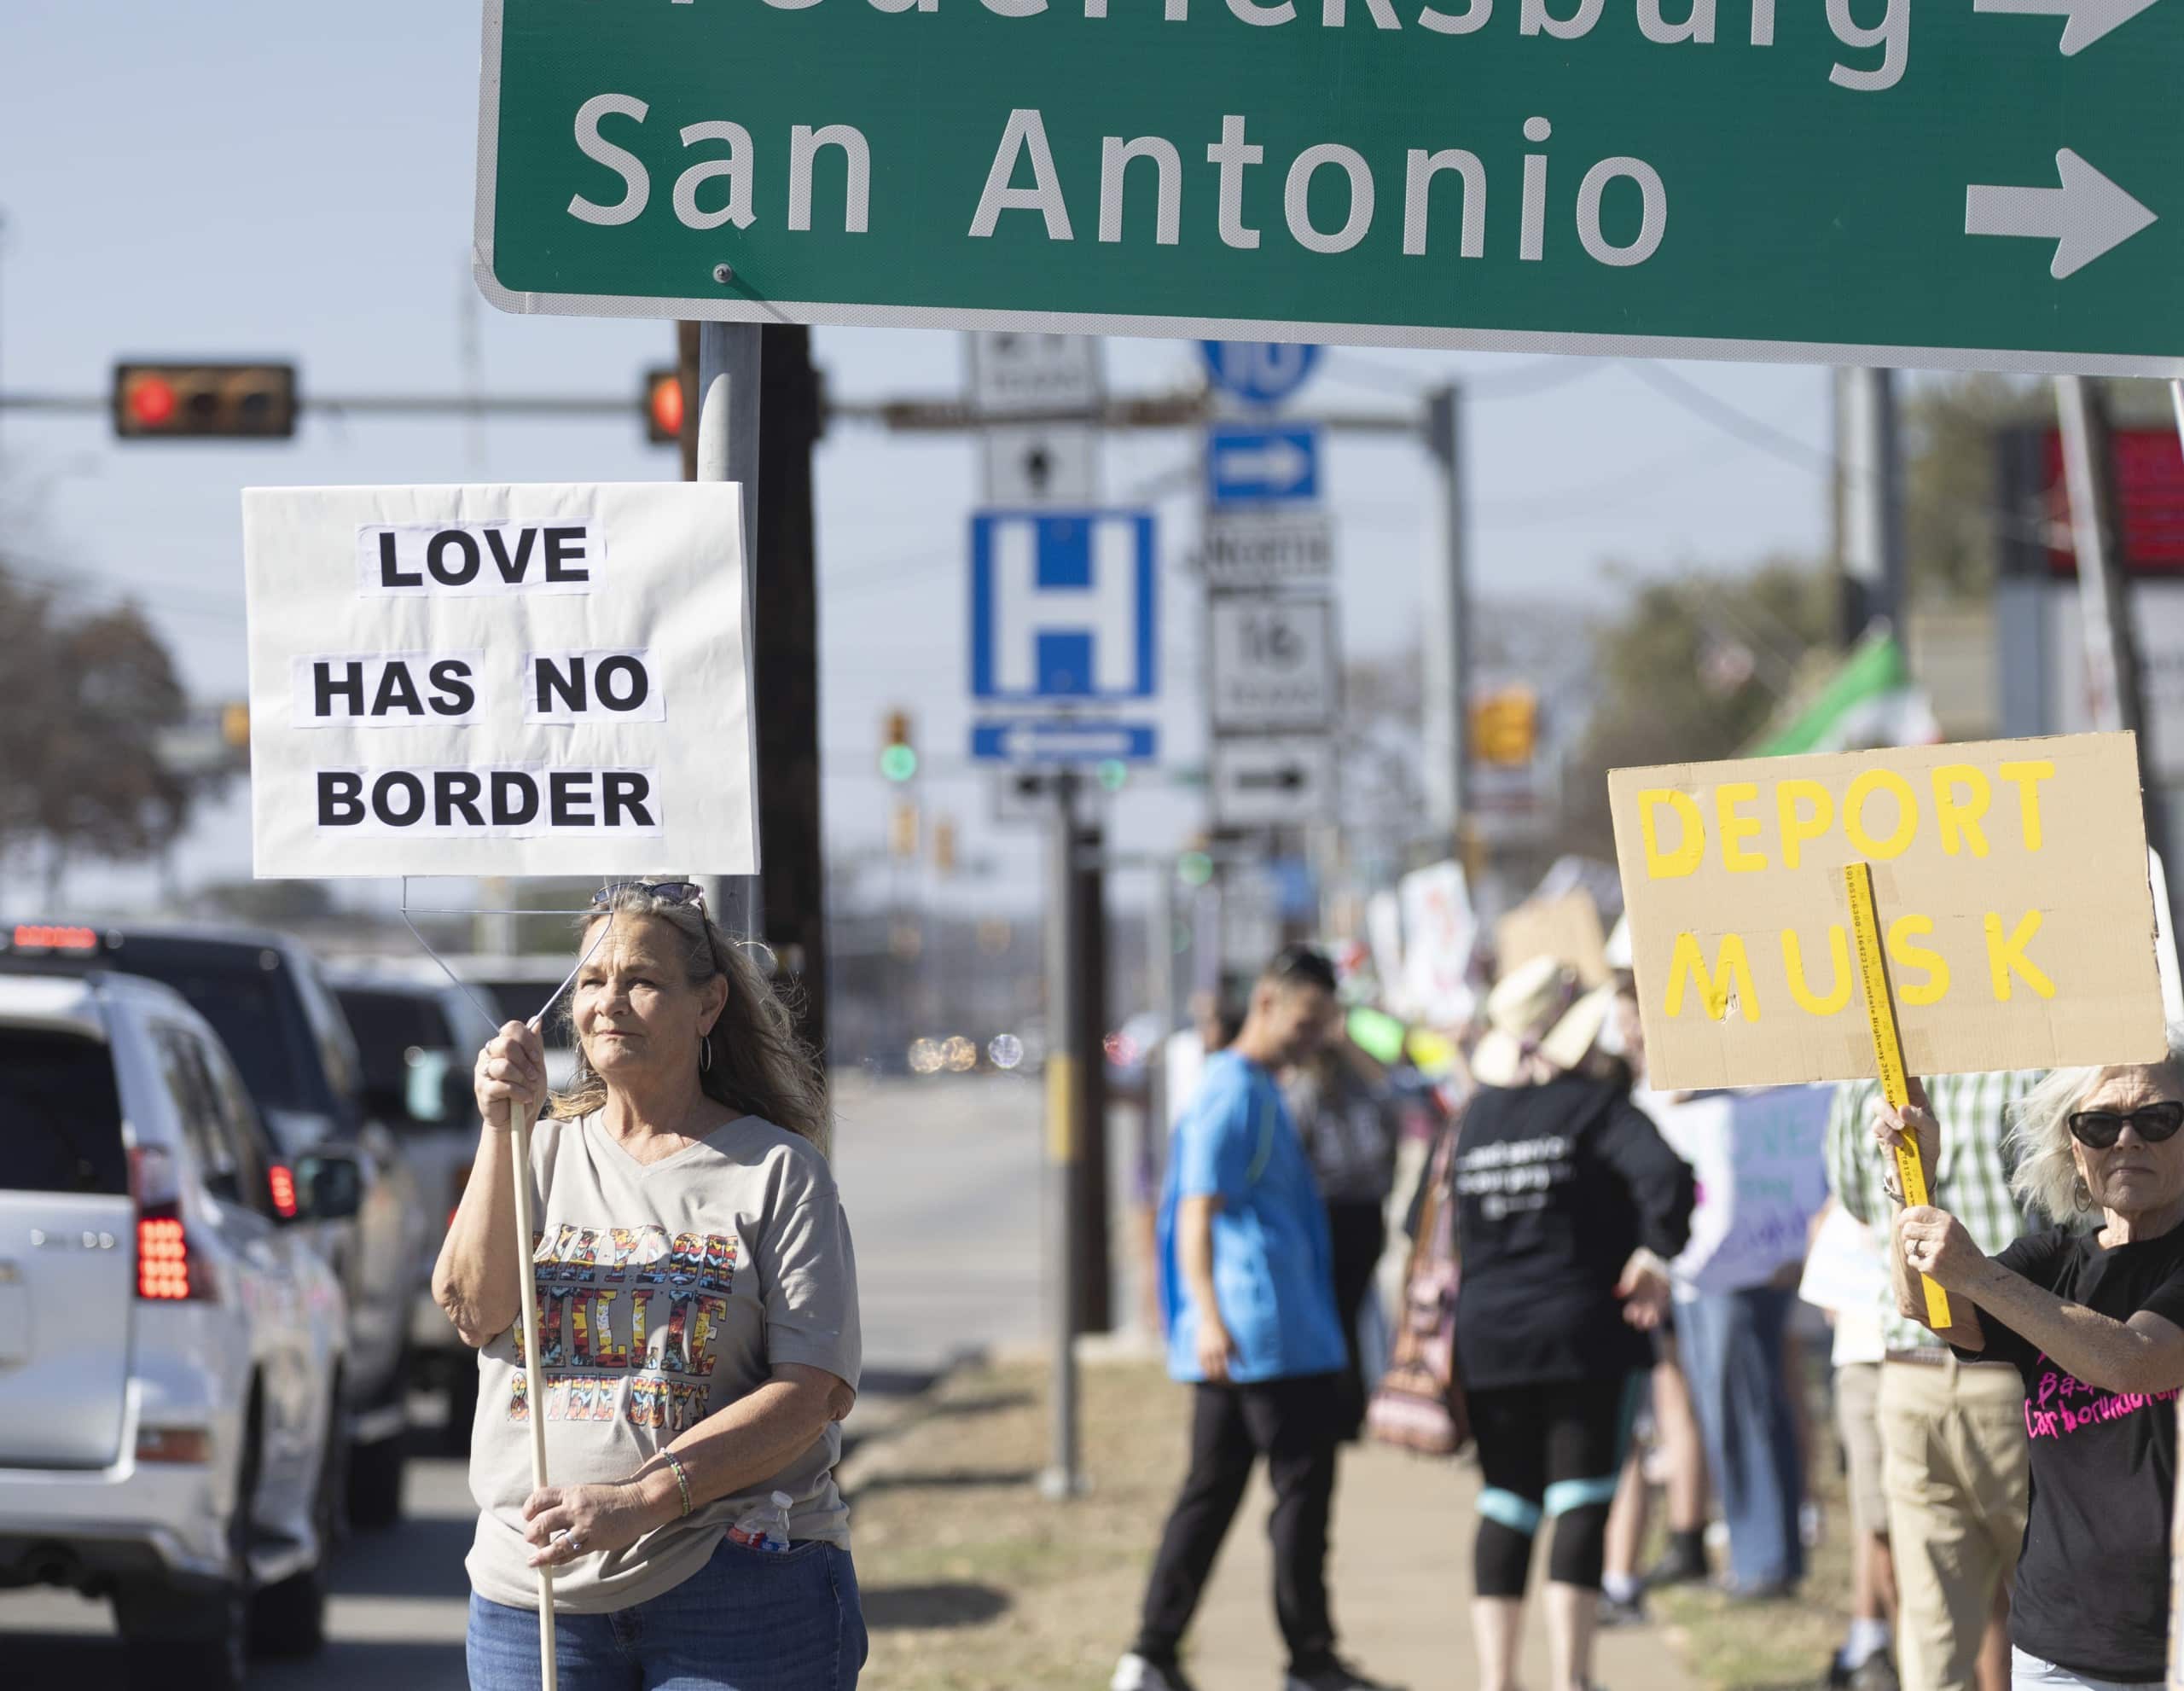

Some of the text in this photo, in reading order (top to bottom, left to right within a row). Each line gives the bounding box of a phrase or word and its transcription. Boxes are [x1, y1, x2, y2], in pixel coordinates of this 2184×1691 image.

[566, 94, 1668, 267] San Antonio
[379, 526, 590, 587] LOVE
[990, 519, 1138, 694] H
[313, 654, 649, 717] HAS NO
[317, 770, 656, 827] BORDER
[1637, 761, 2055, 880] DEPORT
[1664, 909, 2055, 1023] MUSK
[513, 1286, 728, 1376] WILLIE
[546, 1372, 621, 1421] THE
